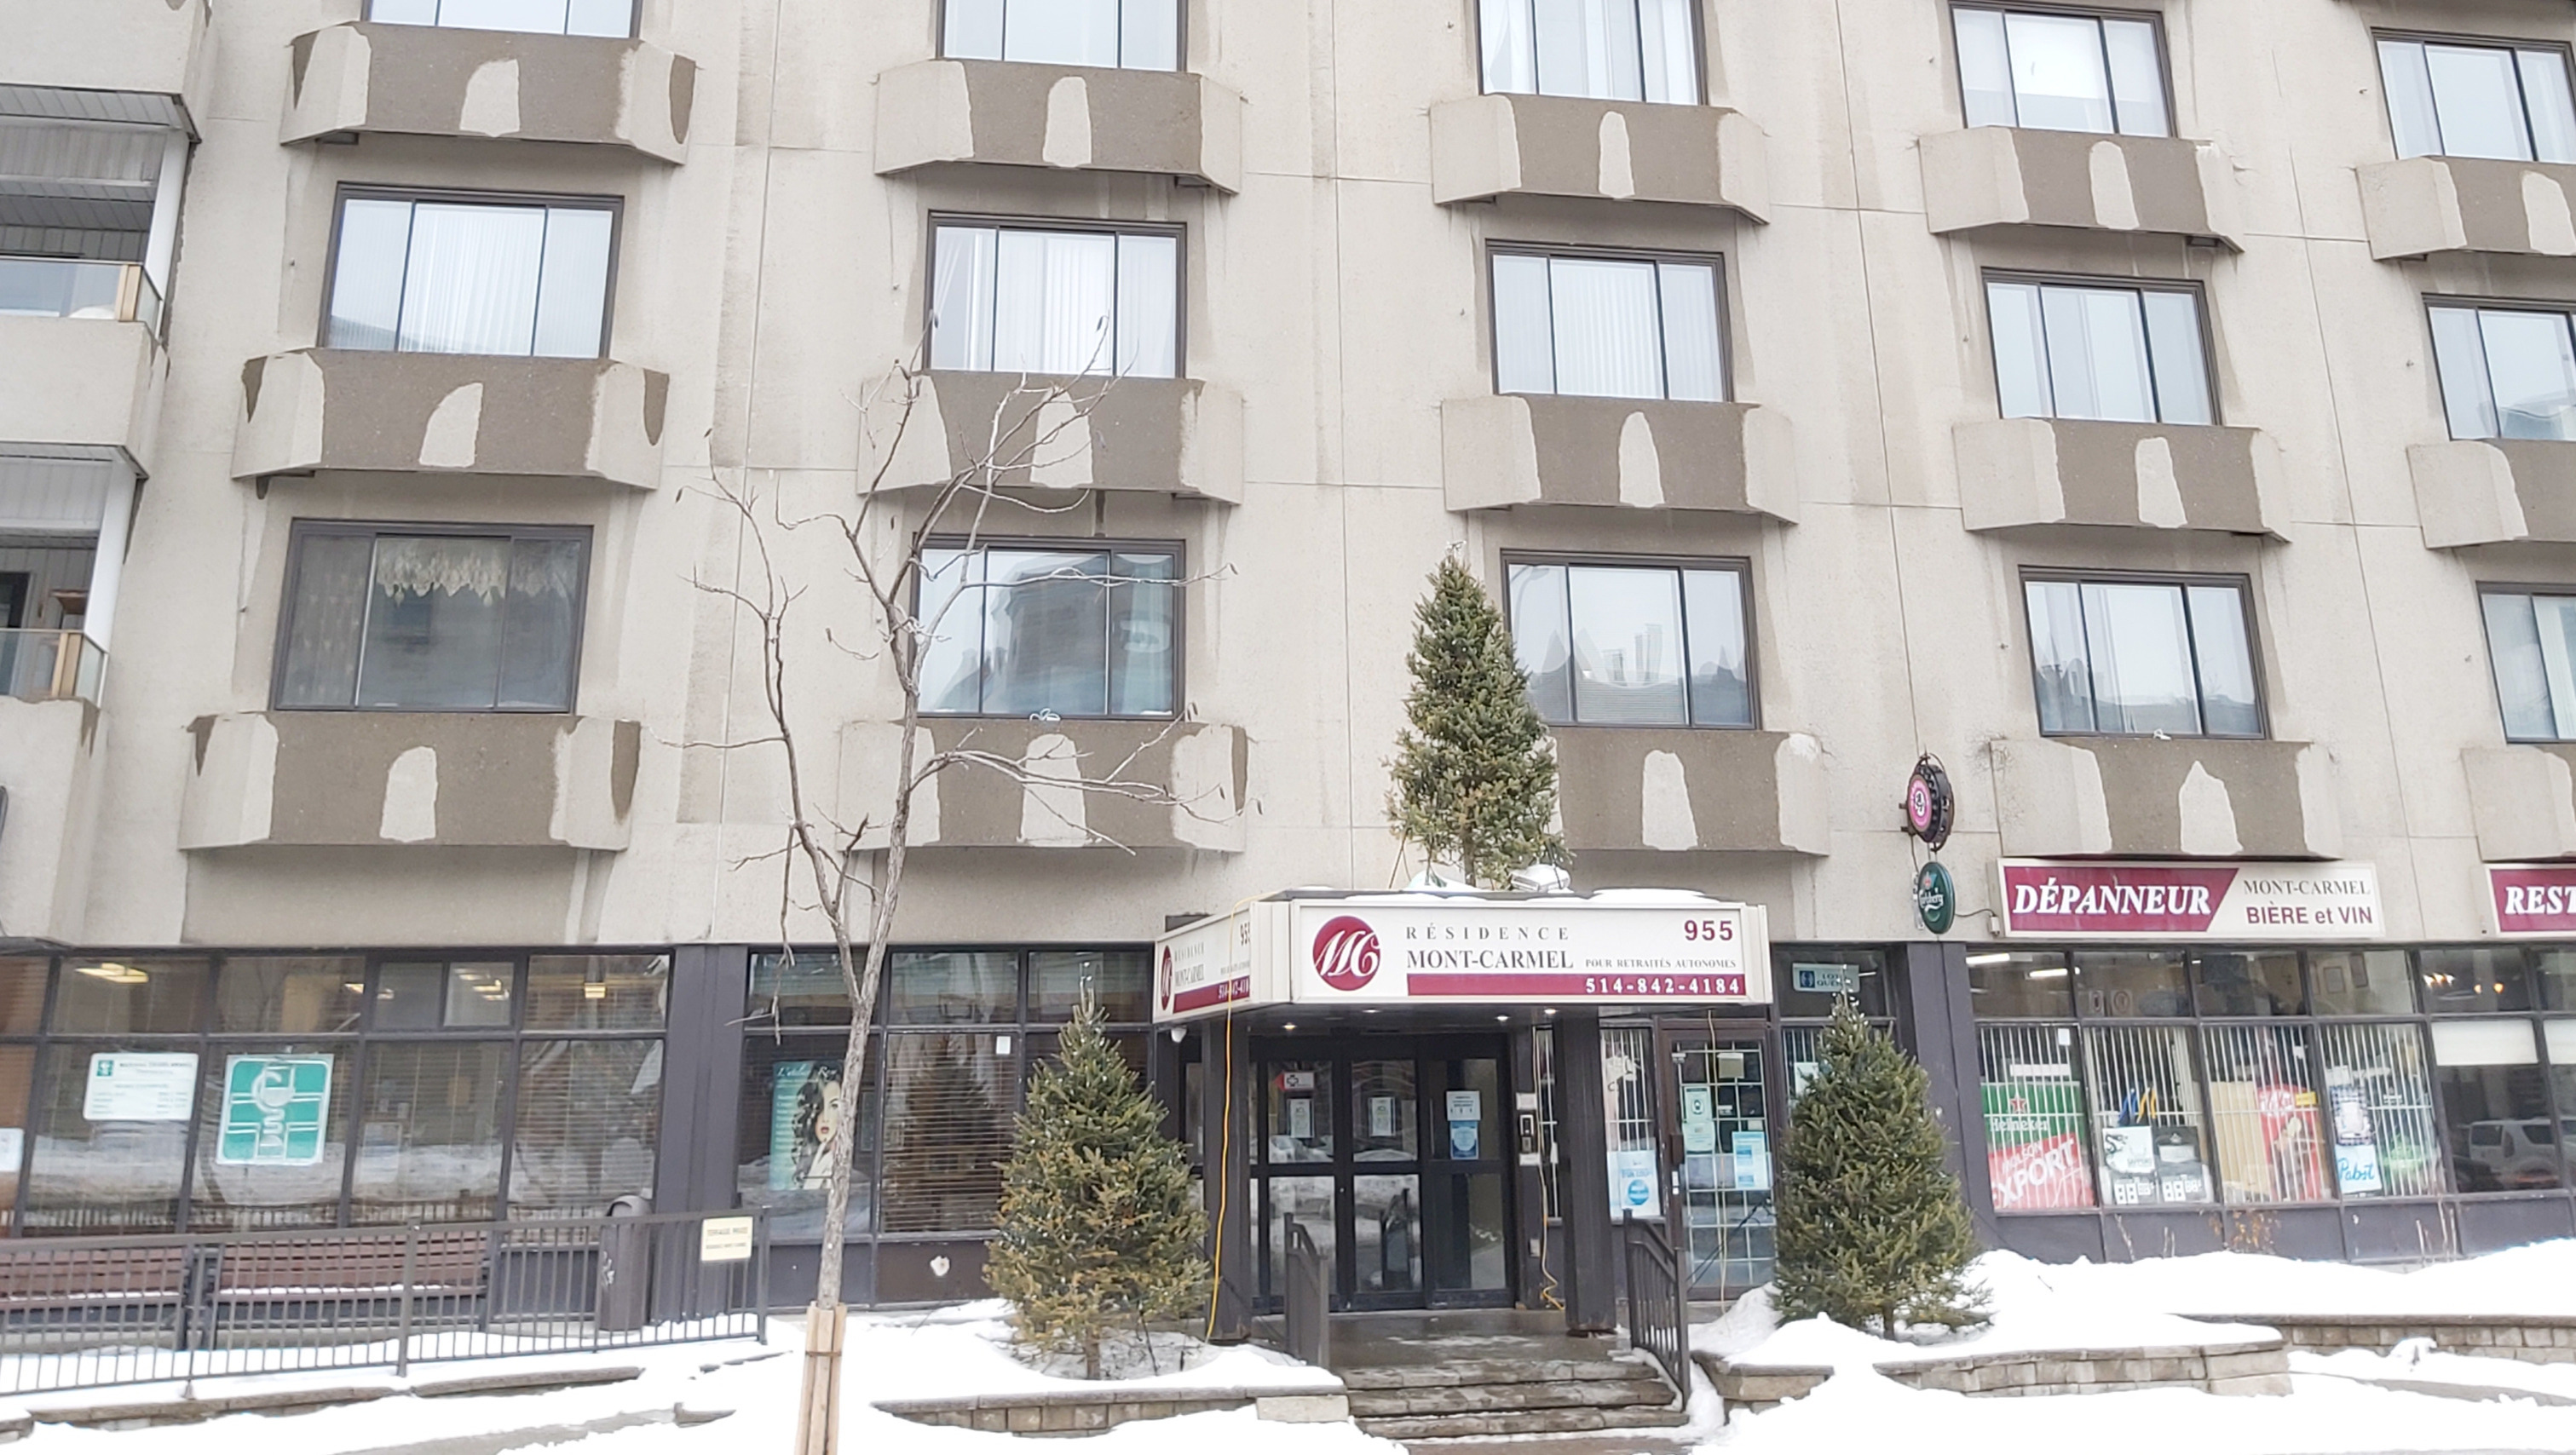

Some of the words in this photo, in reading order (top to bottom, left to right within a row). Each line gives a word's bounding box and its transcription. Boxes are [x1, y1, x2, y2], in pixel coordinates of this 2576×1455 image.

[2012, 877, 2212, 915] DÉPANNEUR
[2243, 879, 2371, 895] MONT-CARMEL
[2245, 900, 2309, 924] BIÈRE
[2314, 907, 2334, 924] et
[2338, 906, 2373, 924] VIN
[1406, 923, 1569, 940] RÉSIDENCE
[1684, 919, 1733, 941] 955
[1406, 949, 1574, 969] MONT-CARMEL
[1585, 958, 1612, 968] POUR
[1617, 957, 1671, 968] RETRAITÉS
[1674, 958, 1737, 968] AUTONOMES
[1585, 977, 1739, 993] 514-842-4184
[2337, 1157, 2375, 1181] Pabst
